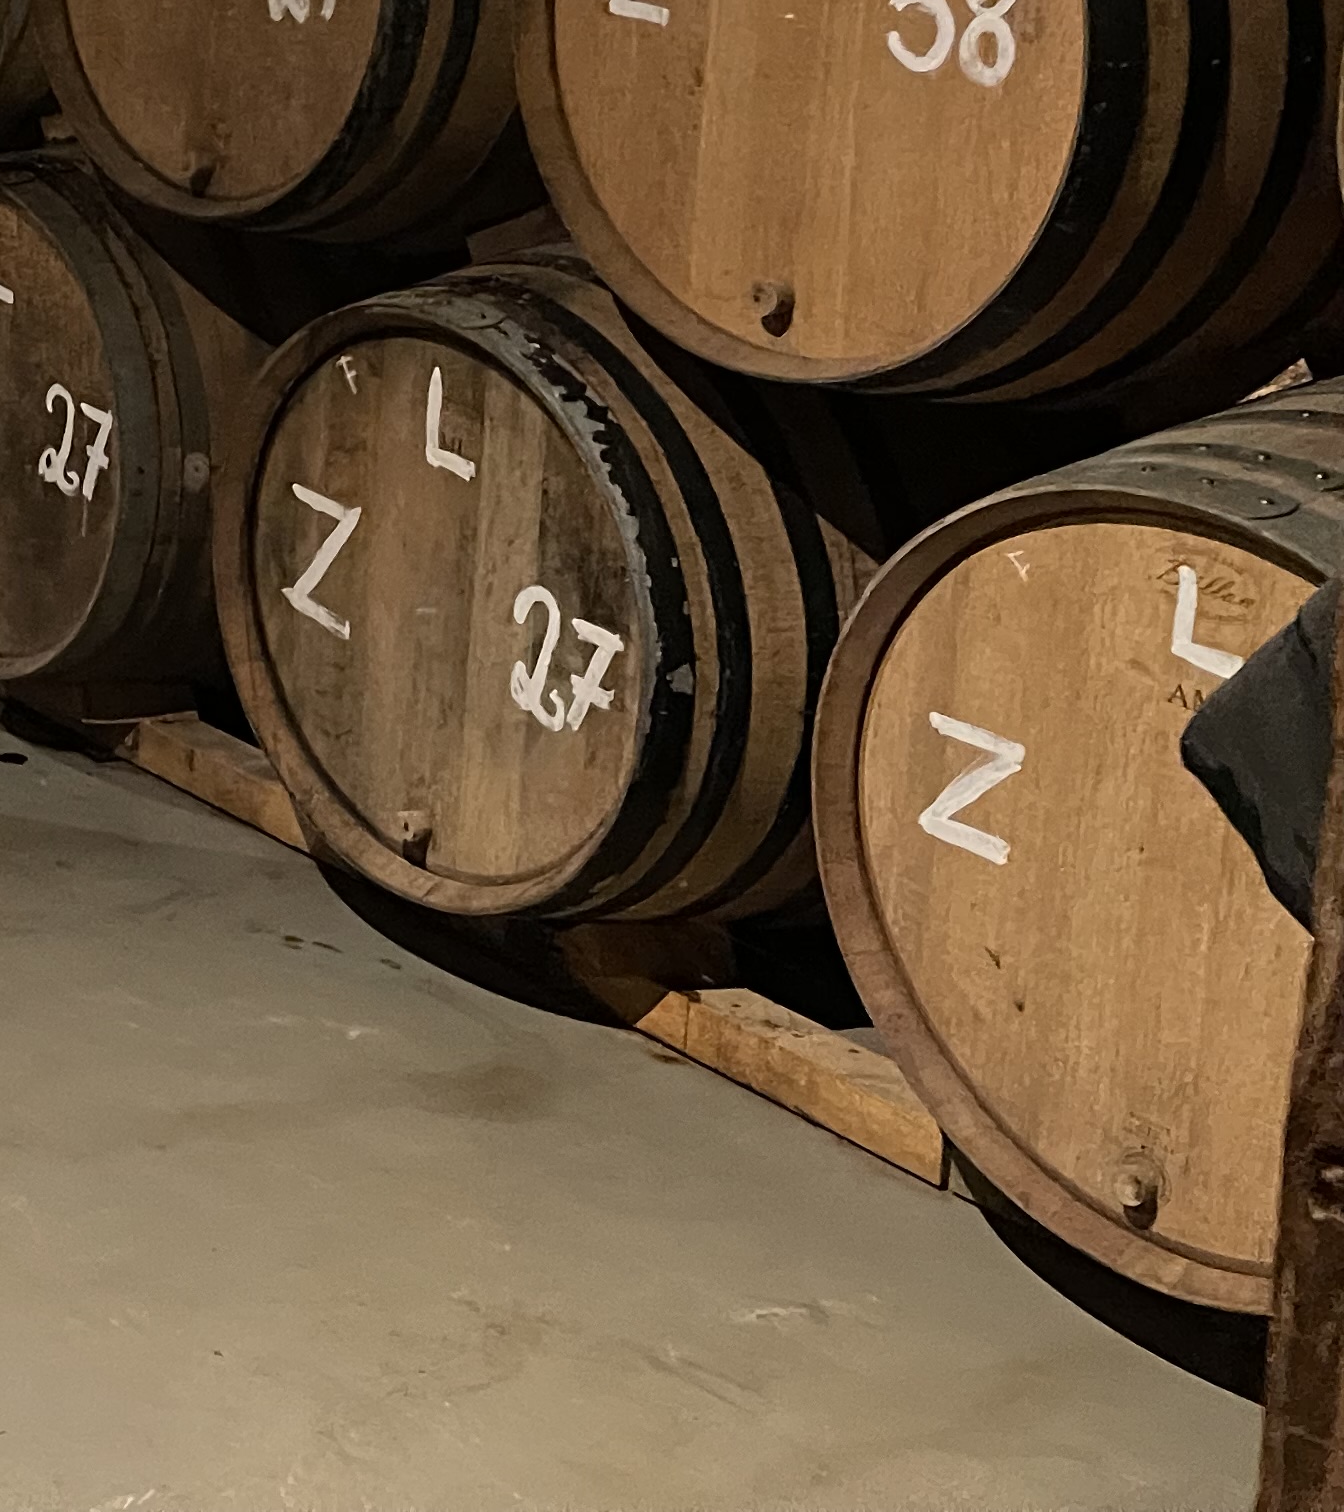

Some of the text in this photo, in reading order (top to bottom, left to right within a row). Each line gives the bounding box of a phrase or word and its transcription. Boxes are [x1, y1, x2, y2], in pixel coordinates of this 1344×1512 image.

[38, 383, 113, 501] 27
[425, 366, 476, 482] L
[281, 483, 625, 732] Z 27
[1170, 564, 1246, 680] L
[918, 711, 1027, 866] Z
